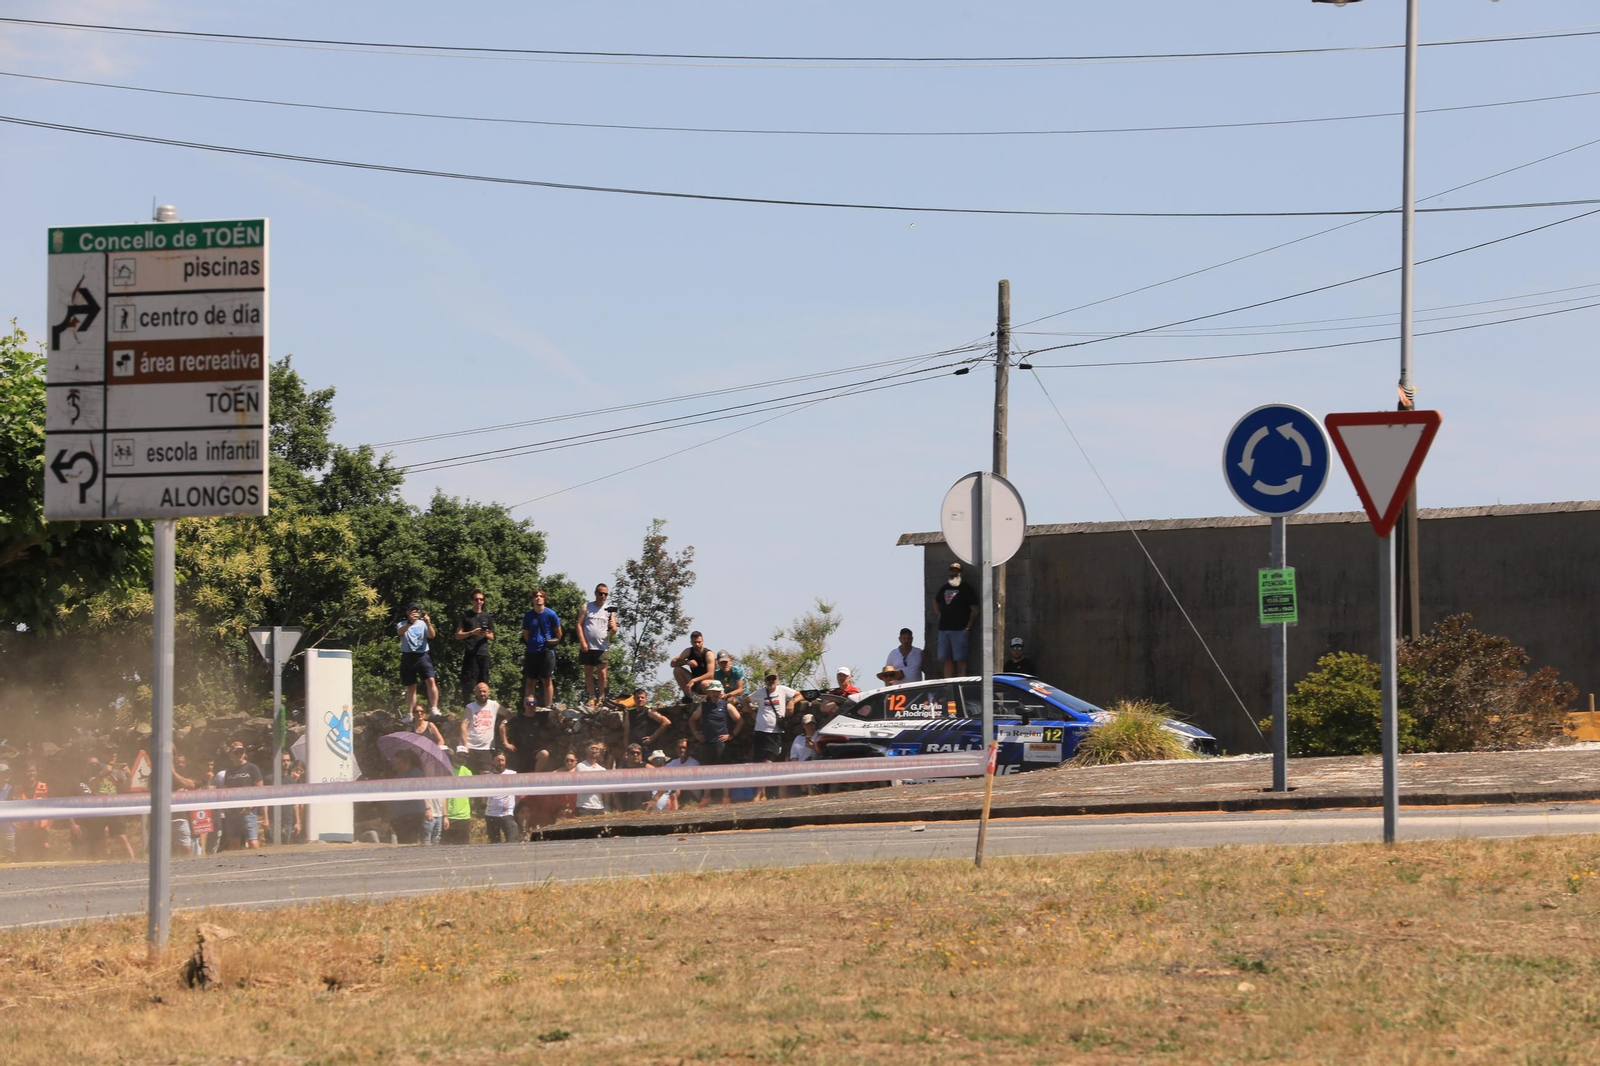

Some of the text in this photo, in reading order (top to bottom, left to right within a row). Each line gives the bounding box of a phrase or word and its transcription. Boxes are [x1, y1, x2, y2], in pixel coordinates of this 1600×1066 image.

[79, 222, 260, 251] Concello de TOÉN
[183, 256, 260, 282] piscinas
[139, 303, 260, 327] centro de día
[139, 350, 260, 373] área recreativa
[146, 440, 260, 463] escola infantil
[160, 485, 260, 508] ALONGOS
[887, 694, 907, 711] 12
[1045, 728, 1062, 741] 12
